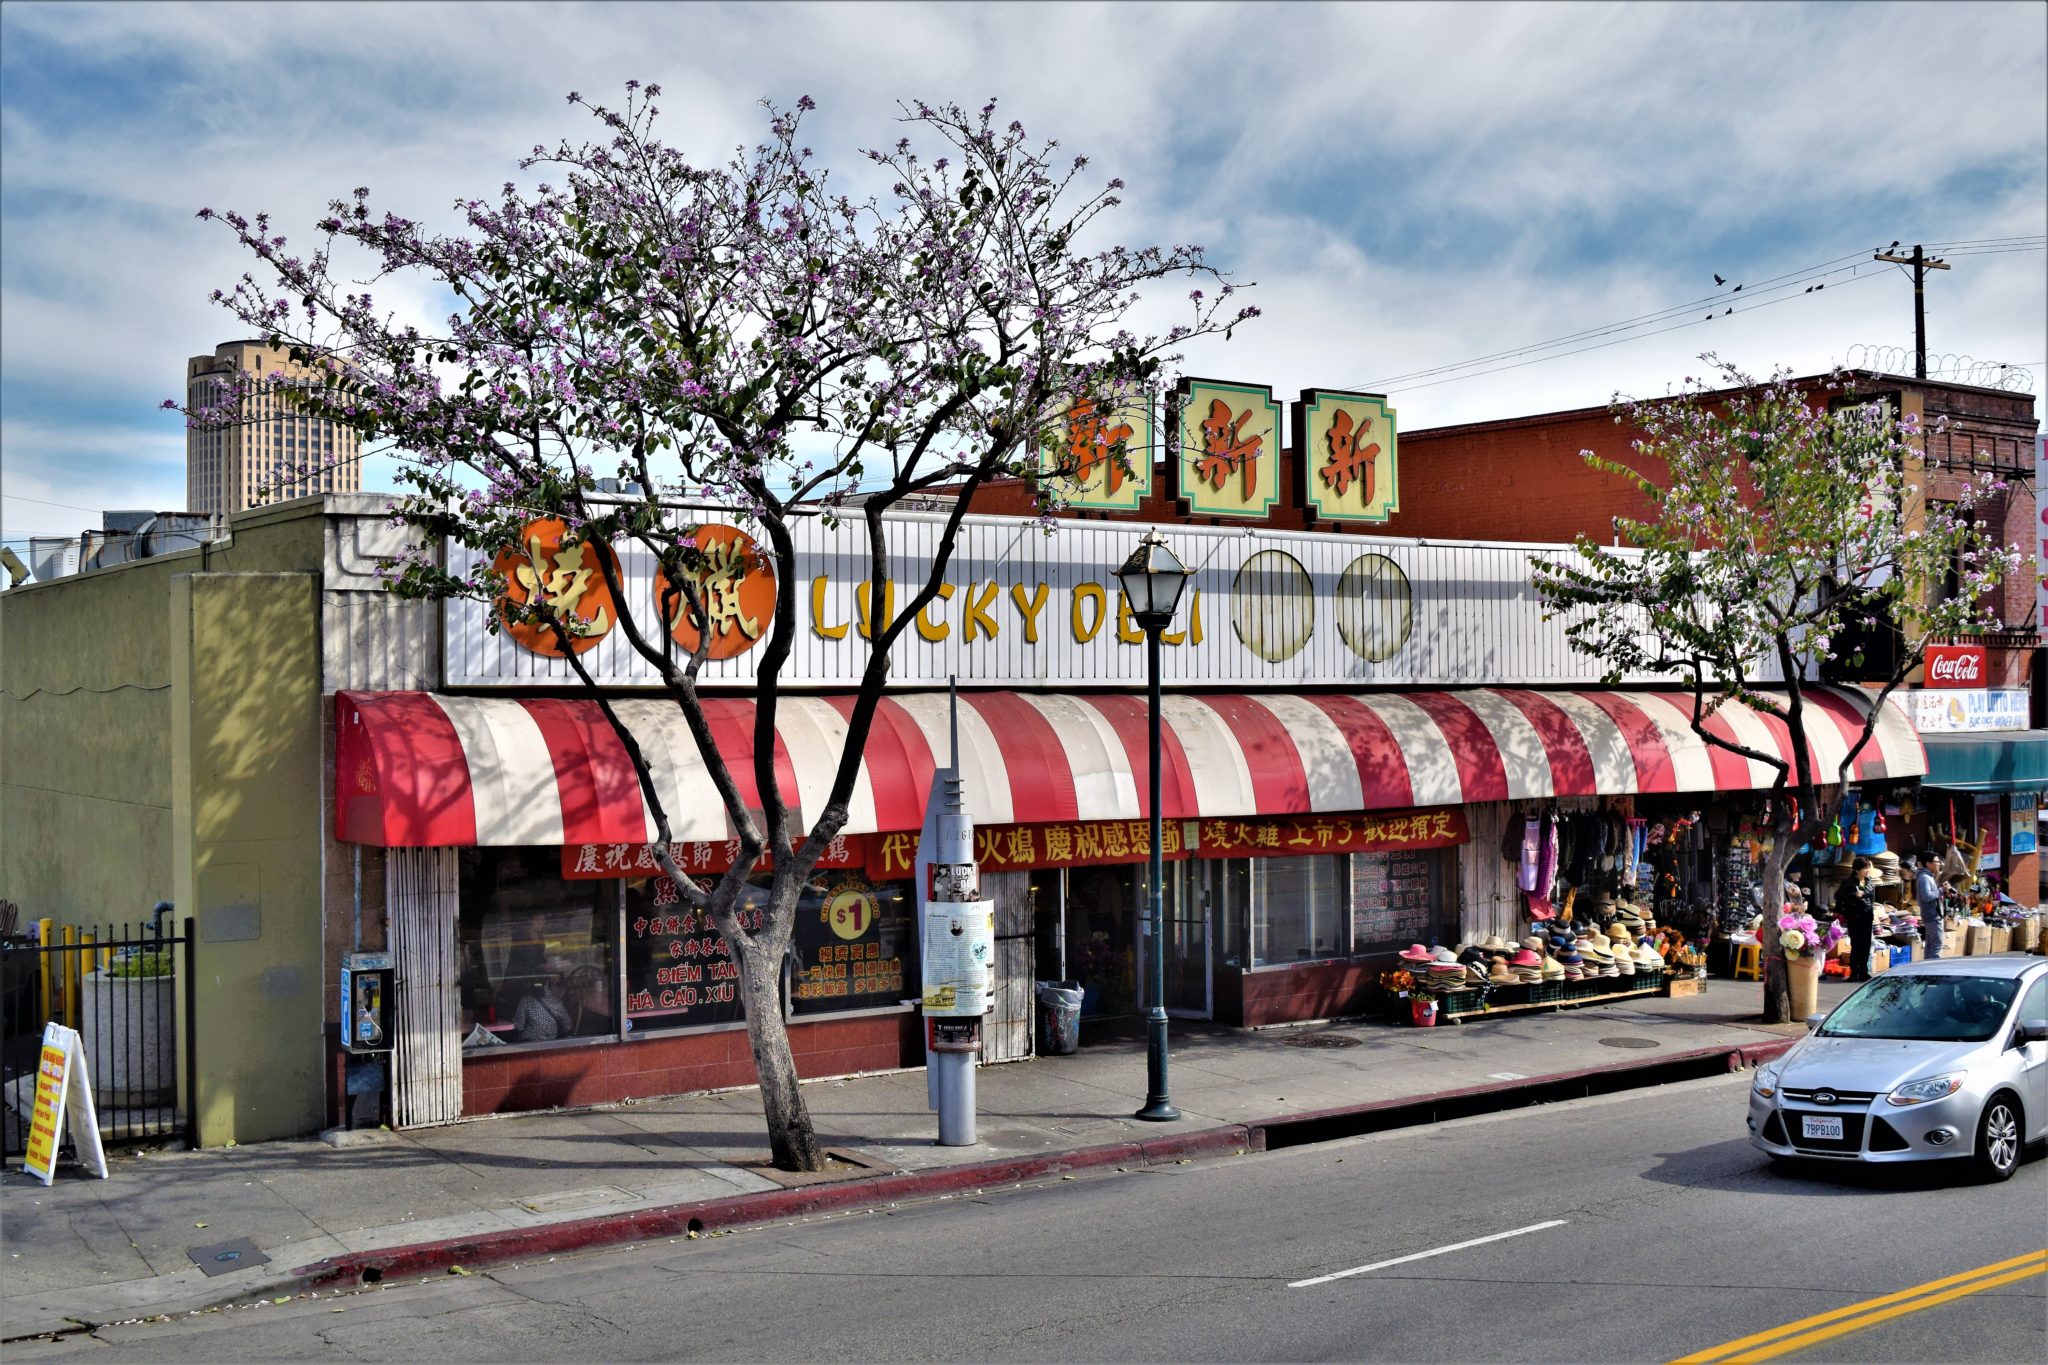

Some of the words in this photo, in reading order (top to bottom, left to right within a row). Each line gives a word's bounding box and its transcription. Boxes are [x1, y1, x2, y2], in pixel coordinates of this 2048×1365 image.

[1198, 398, 1263, 501] 新
[1320, 408, 1381, 506] 新
[811, 574, 1050, 645] LUCKY
[1932, 654, 1979, 680] Coca-Cola
[1987, 692, 2008, 712] LOTTO
[2013, 795, 2034, 811] LUCKY
[836, 898, 863, 931] $1
[1805, 1124, 1840, 1136] 7BPB100
